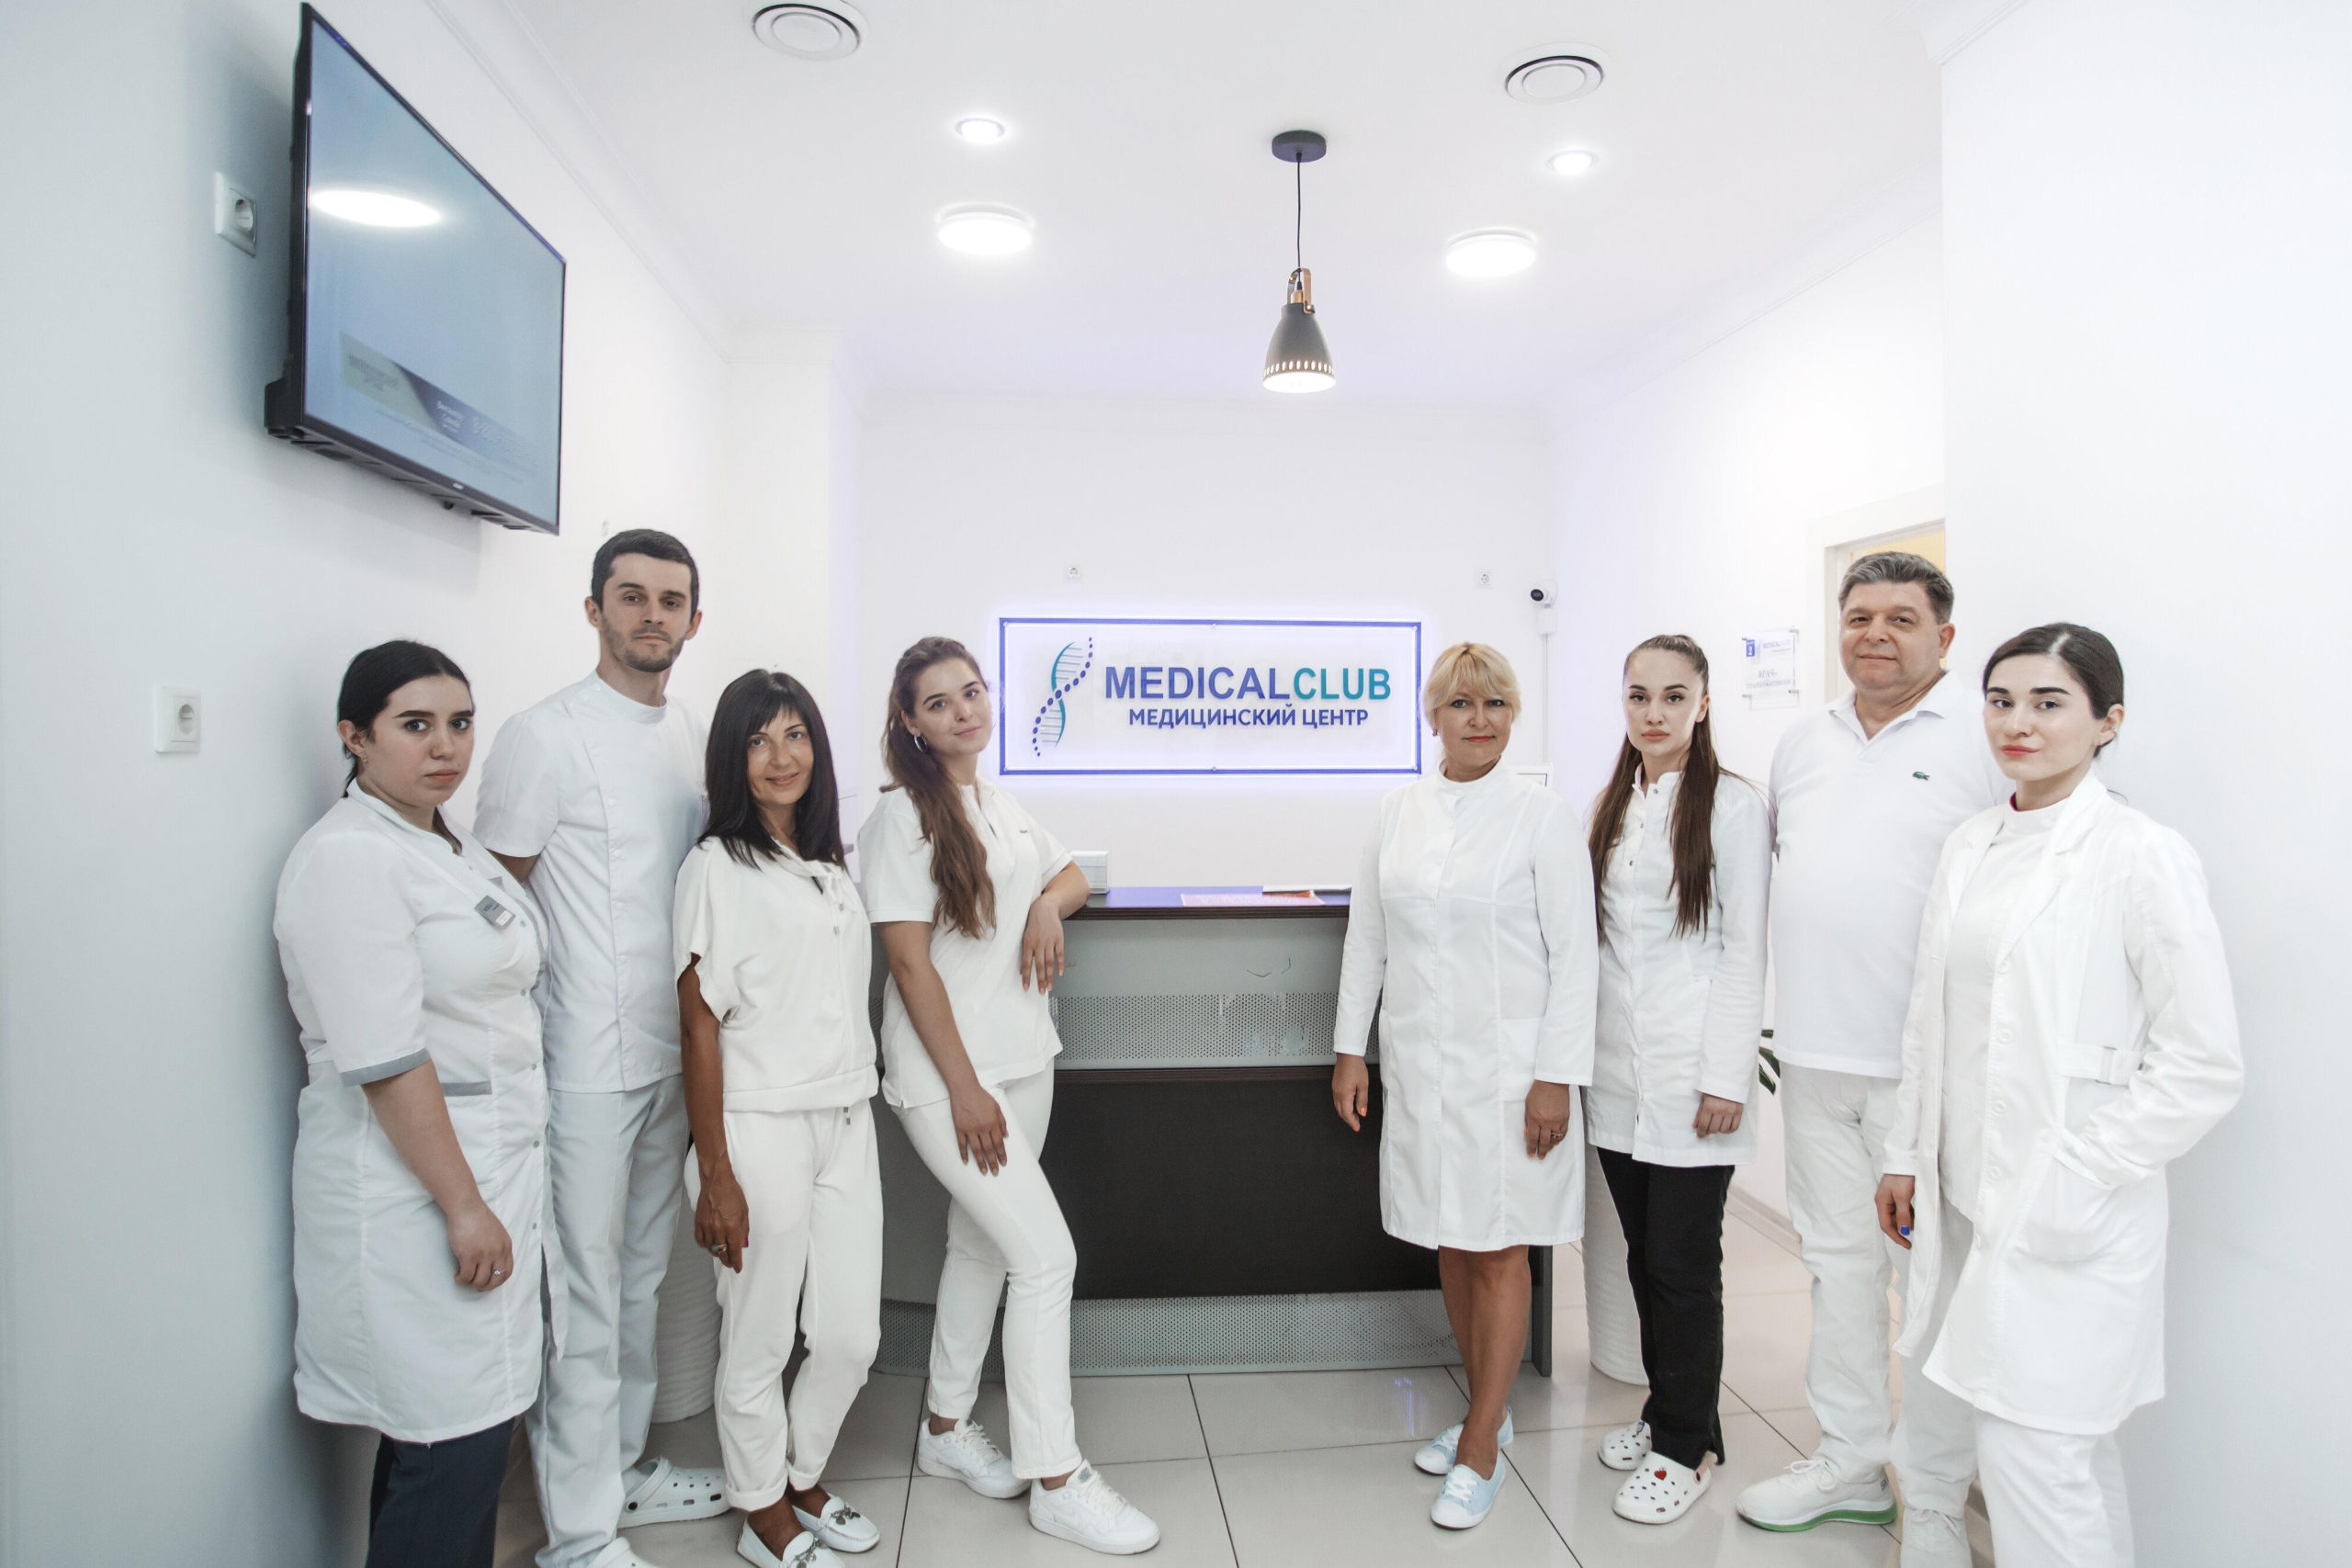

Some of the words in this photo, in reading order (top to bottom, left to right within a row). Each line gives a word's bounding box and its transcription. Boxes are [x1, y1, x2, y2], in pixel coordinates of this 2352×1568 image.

[1105, 666, 1391, 700] MEDICALCLUB
[1128, 704, 1295, 728] МЕДИЦИНСКИЙ
[1302, 709, 1368, 728] ЦЕНТР
